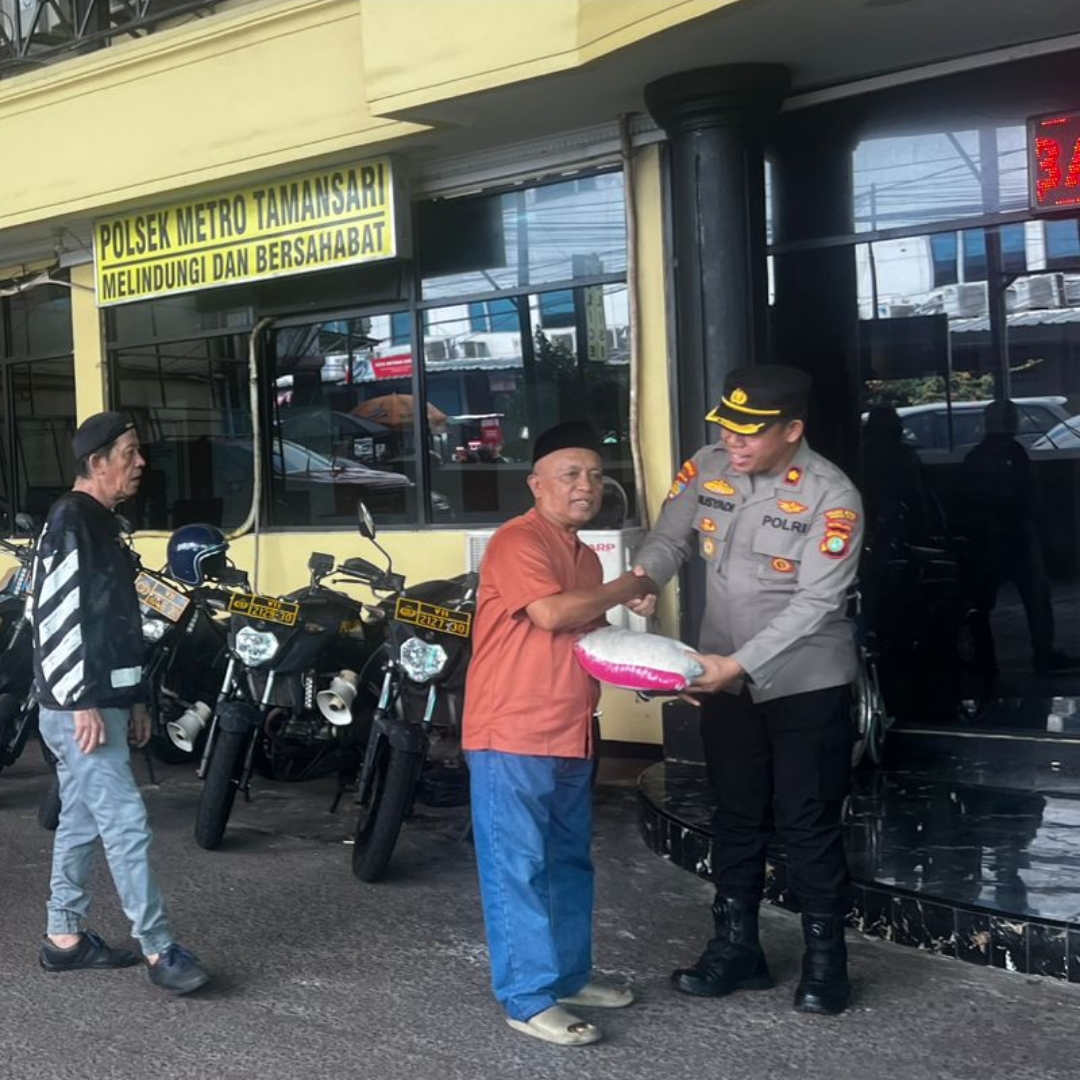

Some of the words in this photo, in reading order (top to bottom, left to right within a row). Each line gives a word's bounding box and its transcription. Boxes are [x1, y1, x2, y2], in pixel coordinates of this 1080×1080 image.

[99, 210, 171, 261] POLSEK
[176, 193, 247, 246] METRO
[253, 163, 386, 230] TAMANSARI
[102, 256, 206, 300] MELINDUNGI
[213, 248, 249, 280] DAN
[256, 221, 386, 273] BERSAHABAT
[588, 543, 616, 552] ARP
[761, 515, 808, 533] POLRI
